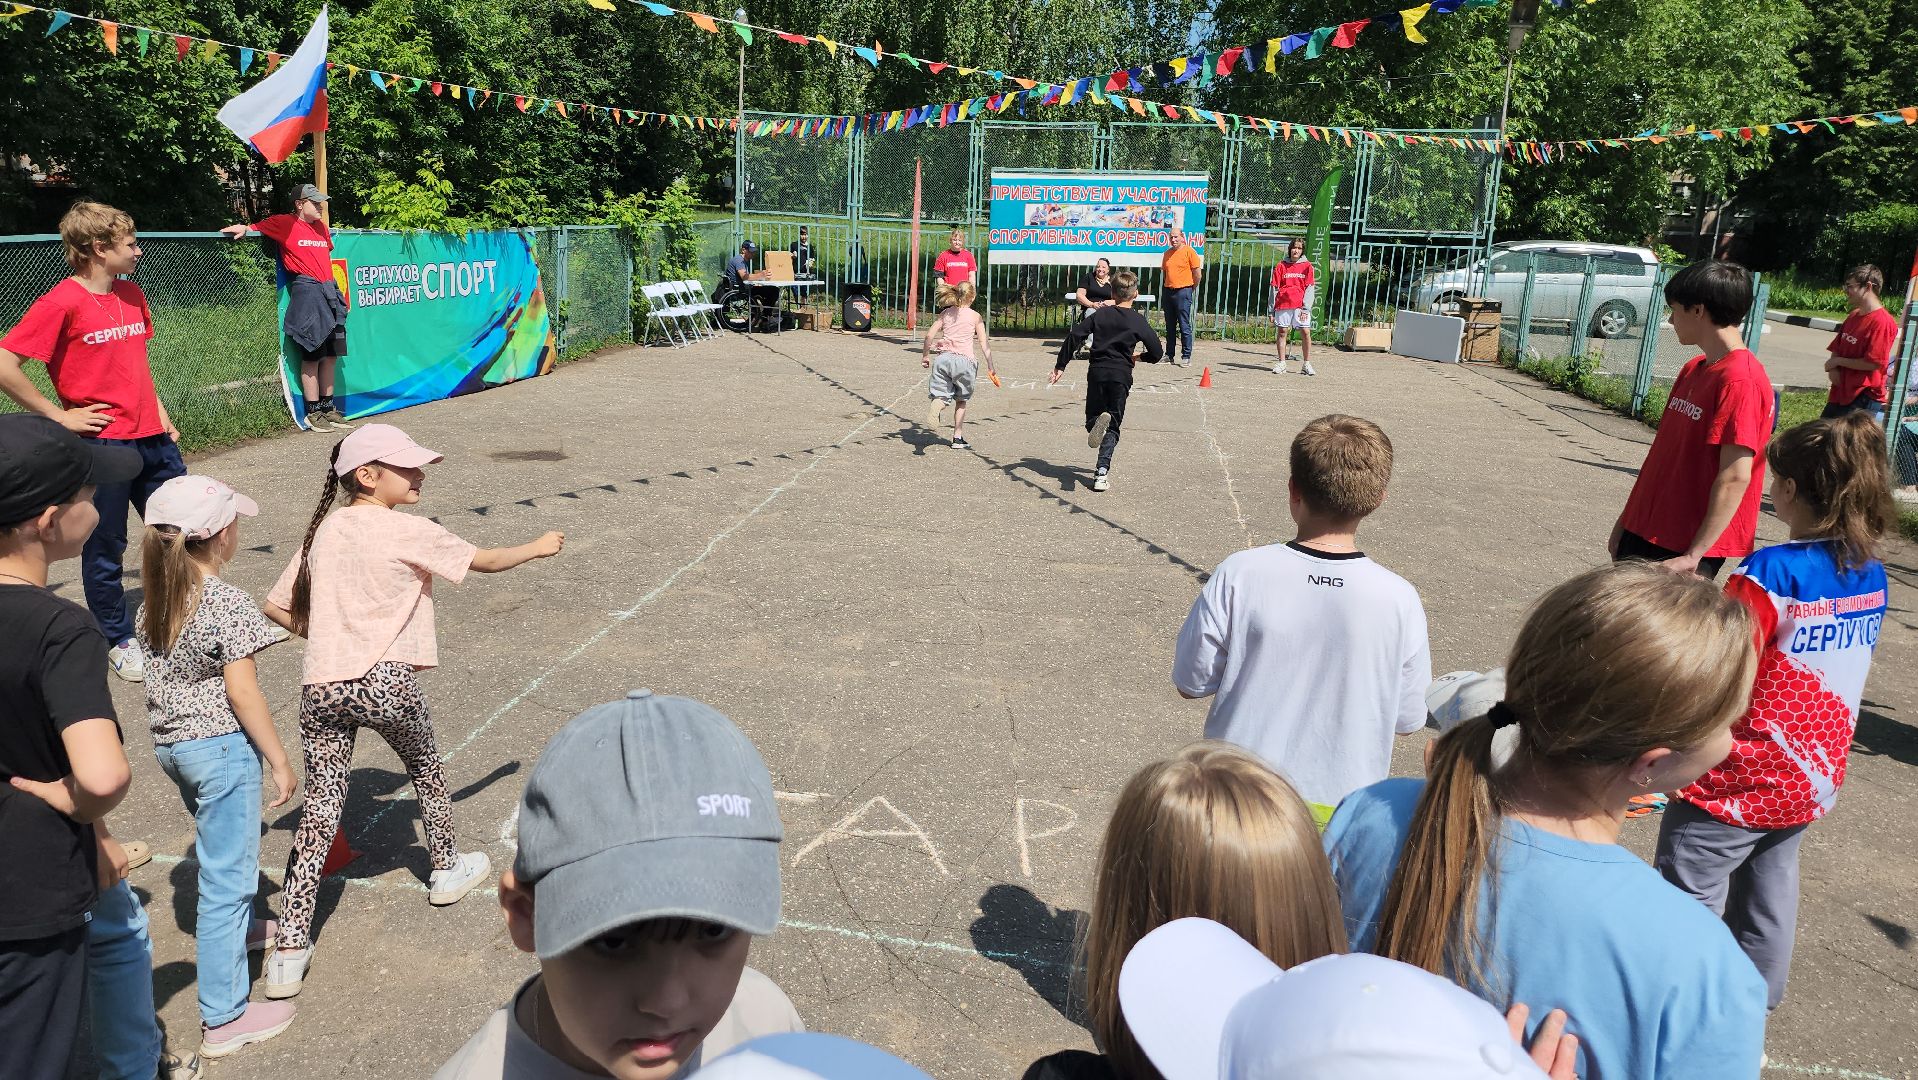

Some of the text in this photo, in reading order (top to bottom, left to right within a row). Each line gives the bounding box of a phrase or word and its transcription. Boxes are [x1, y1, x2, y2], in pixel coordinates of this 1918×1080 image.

[990, 185, 1113, 202] ПРИВЕТСТВУЕМ
[989, 229, 1205, 248] СПОРТИВНЫХ СОРЕВНОНИ
[355, 259, 497, 300] СЕРПУХОВ СПОРТ
[358, 284, 421, 308] ВЫБИРАЕТ
[1307, 574, 1344, 588] NRG
[1786, 600, 1836, 619] РАВНЫЕ
[697, 793, 752, 819] SPORT
